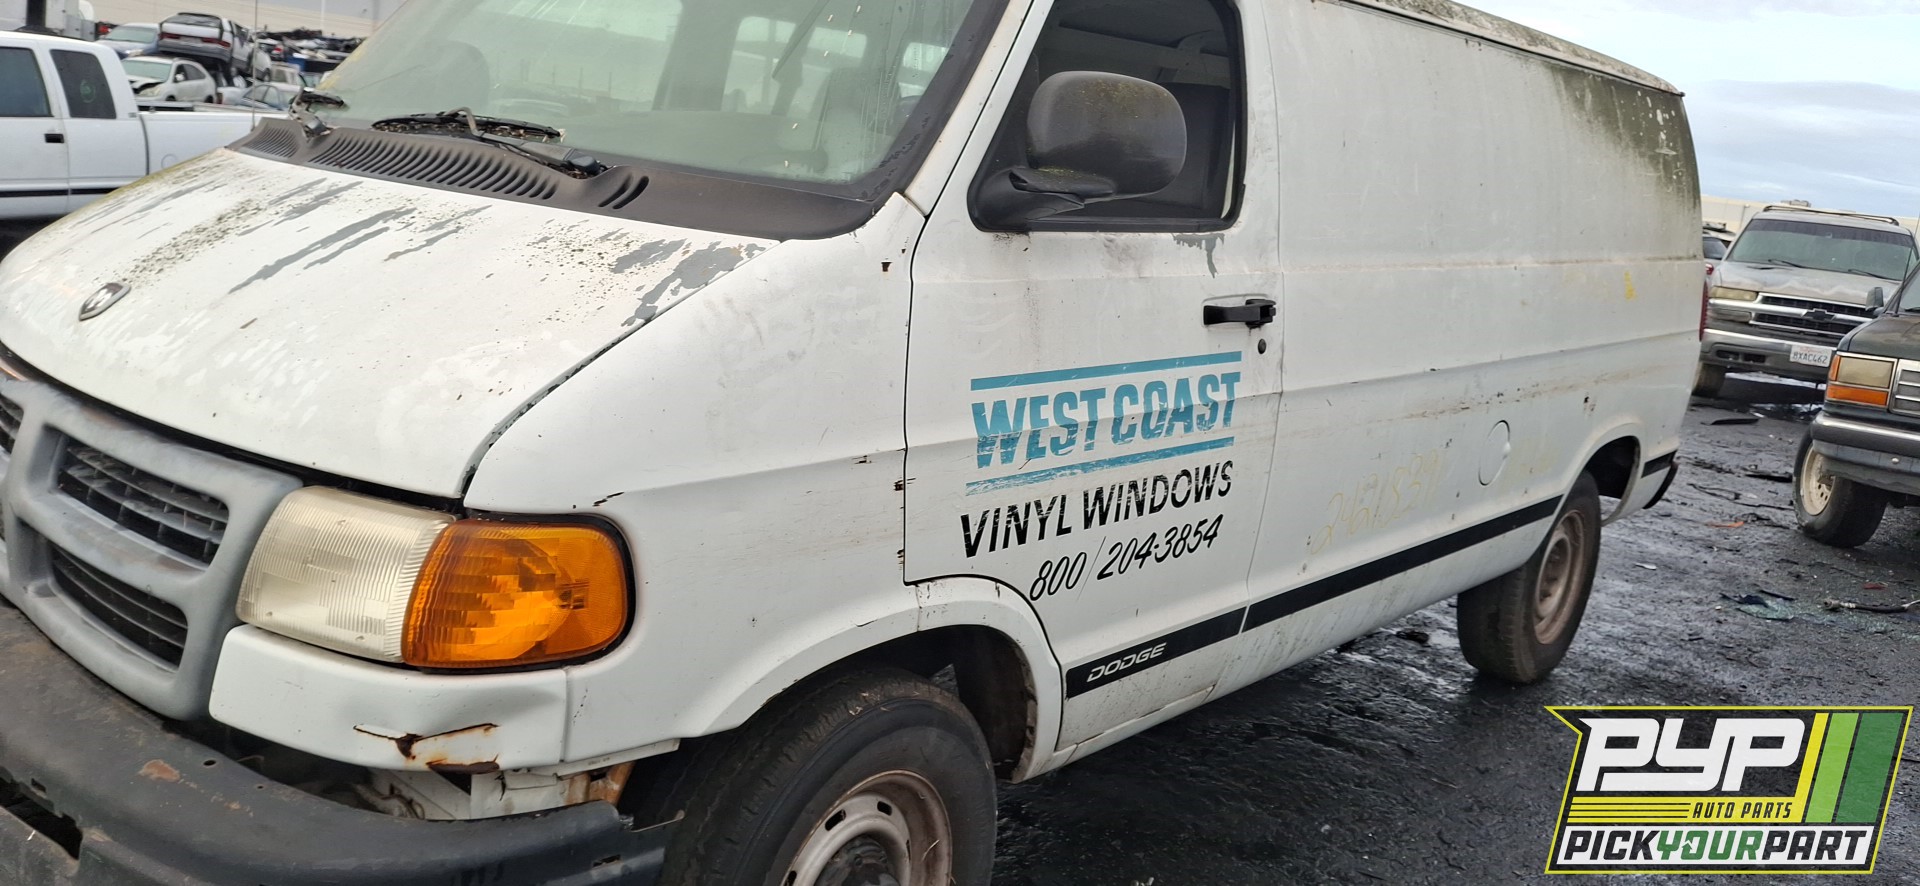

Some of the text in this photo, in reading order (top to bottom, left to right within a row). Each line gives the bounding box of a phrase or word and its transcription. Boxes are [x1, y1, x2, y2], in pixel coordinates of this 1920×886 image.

[971, 371, 1241, 469] WEST COAST
[960, 460, 1234, 558] VINYL WINDOWS
[1086, 642, 1168, 684] DODGE
